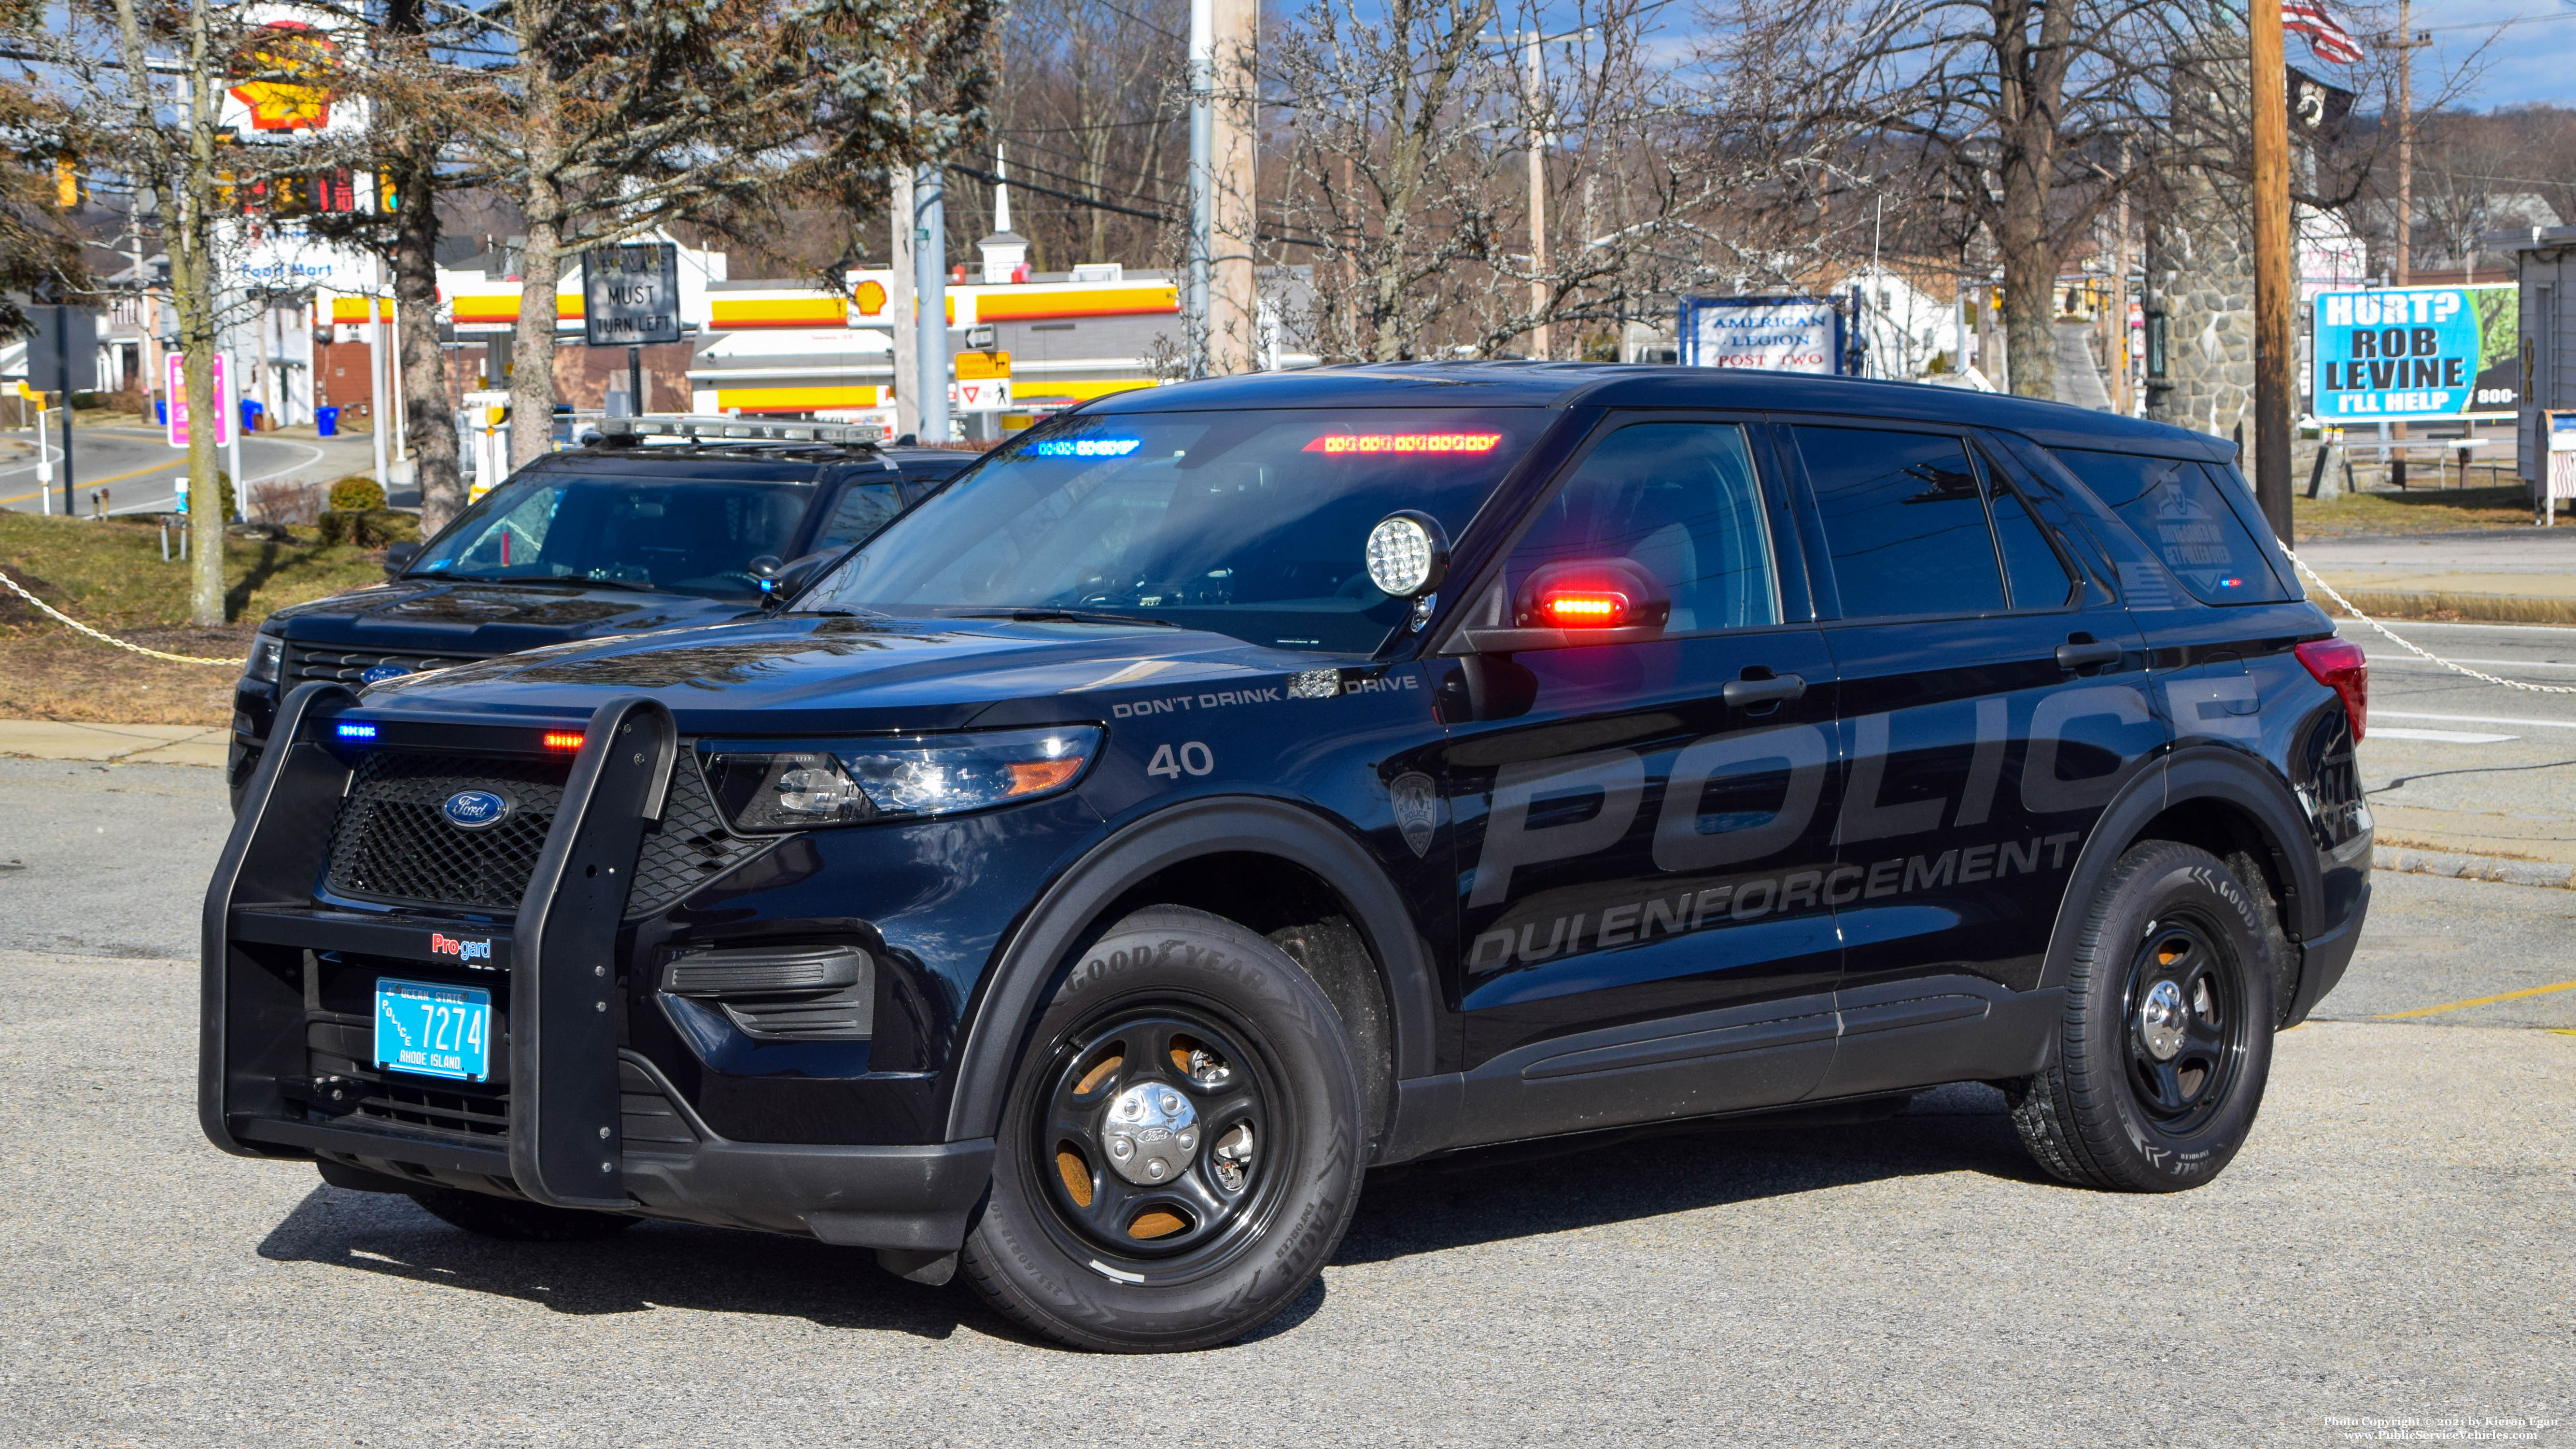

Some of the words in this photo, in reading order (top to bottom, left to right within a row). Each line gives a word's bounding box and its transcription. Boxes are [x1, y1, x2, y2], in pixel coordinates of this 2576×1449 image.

[630, 254, 667, 274] LAE
[607, 285, 654, 305] MUST
[2326, 292, 2461, 326] HURT?
[596, 317, 633, 333] TURN
[638, 315, 670, 331] LEFT
[1713, 316, 1827, 328] AMERICAN
[1731, 334, 1810, 346] LEGION
[2352, 327, 2439, 360] ROB
[1718, 354, 1766, 367] POST
[1778, 353, 1823, 365] TWO
[2326, 358, 2466, 392] LEVINE
[2338, 393, 2380, 413] I'LL
[2385, 391, 2449, 412] HELP
[1112, 696, 1194, 718] DON'T
[1199, 687, 1282, 708] DRINK
[1286, 682, 1339, 700] AND
[1343, 675, 1419, 695] DRIVE
[1147, 741, 1214, 779] 40
[1467, 675, 2261, 910] POLICE
[453, 795, 489, 817] Ford
[1404, 810, 1428, 822] POLICE
[1468, 914, 1586, 974] DUI
[1596, 831, 2080, 948] ENFORCEMENT
[432, 933, 490, 960] Pro-gard
[401, 988, 429, 1001] OCEAN
[436, 992, 464, 1005] STATE
[382, 999, 411, 1047] POLICE
[421, 1004, 481, 1055] 7274
[400, 1049, 427, 1066] RHODE
[430, 1053, 461, 1070] ISLAND
[1145, 1129, 1168, 1142] Ford
[1275, 1201, 1315, 1258] ENFORCER
[1277, 1197, 1335, 1283] EAGLE
